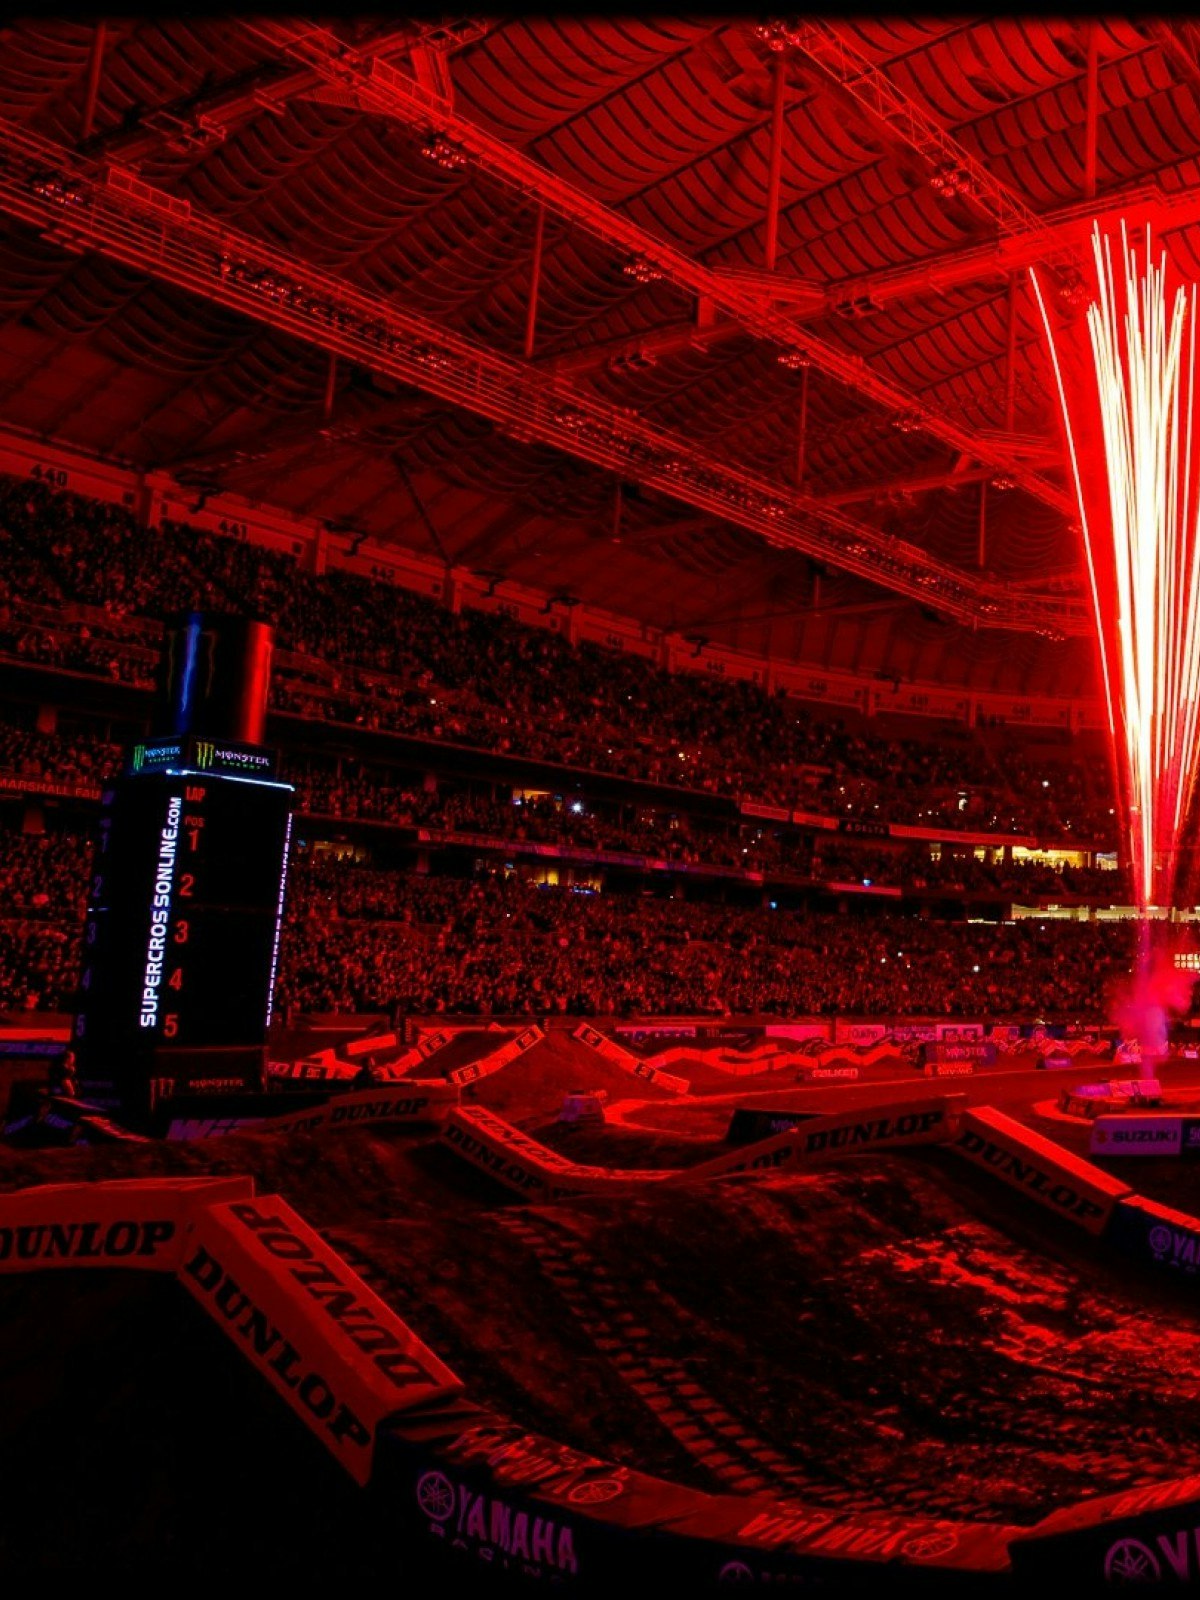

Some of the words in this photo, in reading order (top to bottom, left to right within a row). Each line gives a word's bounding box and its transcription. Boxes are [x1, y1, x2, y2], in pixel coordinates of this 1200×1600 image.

[32, 465, 68, 486] 440
[220, 520, 248, 543] 441
[214, 750, 270, 766] MONSTER
[186, 786, 206, 802] LAP
[188, 829, 199, 851] 1
[178, 872, 195, 897] 2
[173, 920, 190, 945] 3
[168, 967, 184, 991] 4
[163, 1012, 179, 1038] 5
[331, 1097, 428, 1123] DUNLOP
[806, 1111, 944, 1152] DUNLOP
[1112, 1129, 1178, 1143] SUZUKI
[443, 1123, 545, 1190] DUNLOP
[958, 1130, 1103, 1218] DUNLOP
[228, 1203, 440, 1389] DUNLOP
[186, 1247, 370, 1446] DUNLOP
[456, 1482, 580, 1575] YAMAHA
